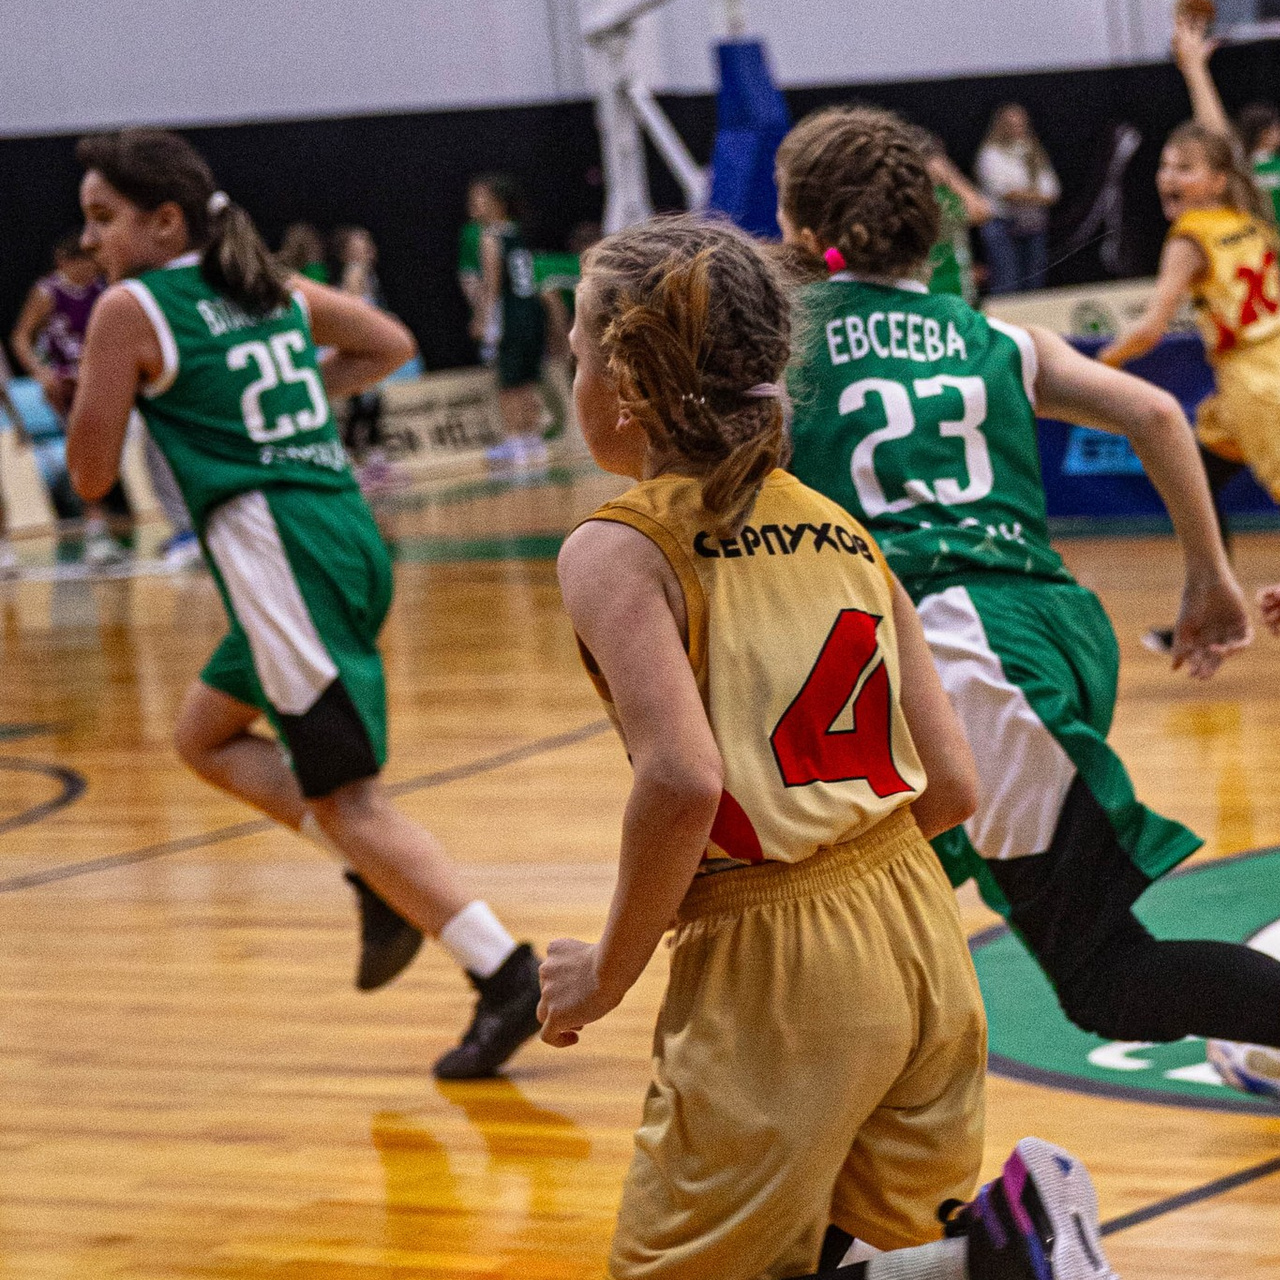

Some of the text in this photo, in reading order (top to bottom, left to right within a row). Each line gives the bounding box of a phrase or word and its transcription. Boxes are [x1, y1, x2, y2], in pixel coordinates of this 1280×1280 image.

[226, 330, 329, 443] 25
[826, 311, 968, 366] ЕВСЕЕВА
[838, 374, 994, 518] 23
[693, 523, 876, 563] СЕРПУХОВ
[769, 608, 916, 798] 4
